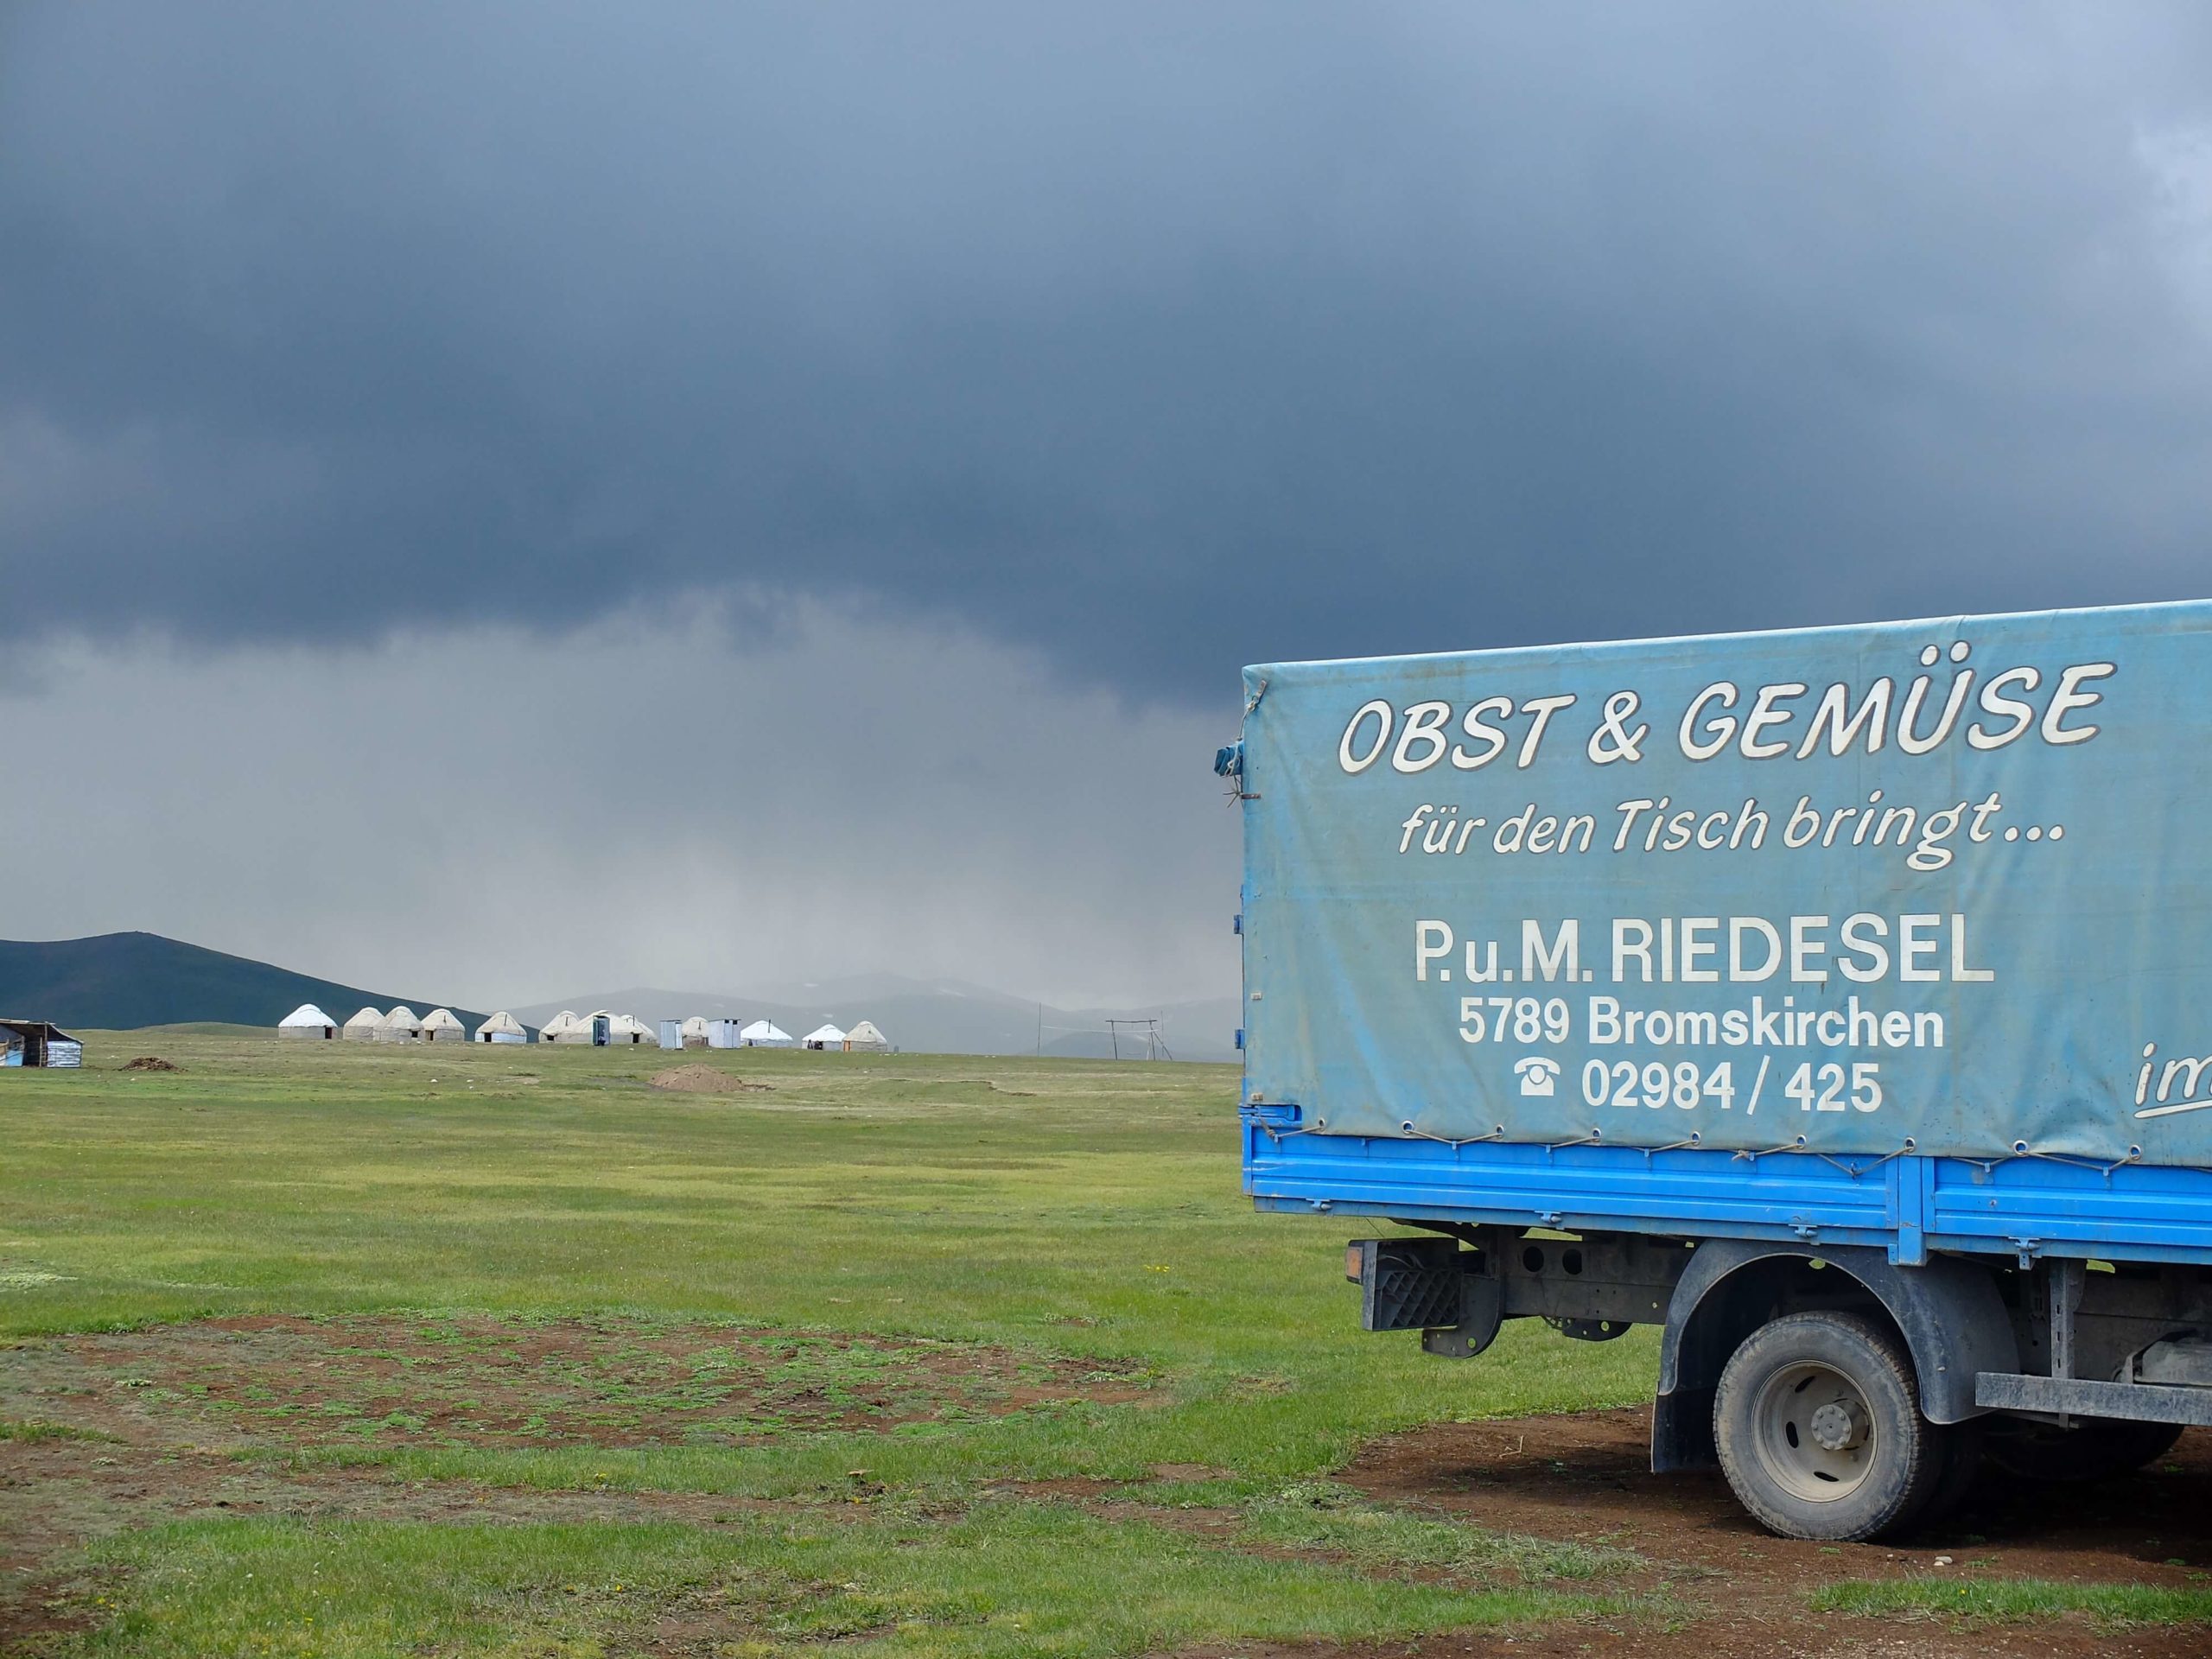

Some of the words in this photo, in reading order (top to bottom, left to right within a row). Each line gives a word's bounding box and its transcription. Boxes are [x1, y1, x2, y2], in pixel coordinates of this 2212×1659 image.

[1338, 694, 1576, 773] OBST
[1586, 690, 1649, 765] &
[1678, 640, 2116, 760] GEMÜSE
[1398, 803, 1486, 855] für
[1492, 804, 1595, 854] den
[1611, 796, 1770, 853] Tisch
[1611, 912, 1995, 983] RIEDESEL
[1458, 996, 1571, 1044] 5789
[1587, 995, 1944, 1048] Bromskirchen
[1580, 1058, 1737, 1109] 02984
[1783, 1062, 1884, 1113] 425
